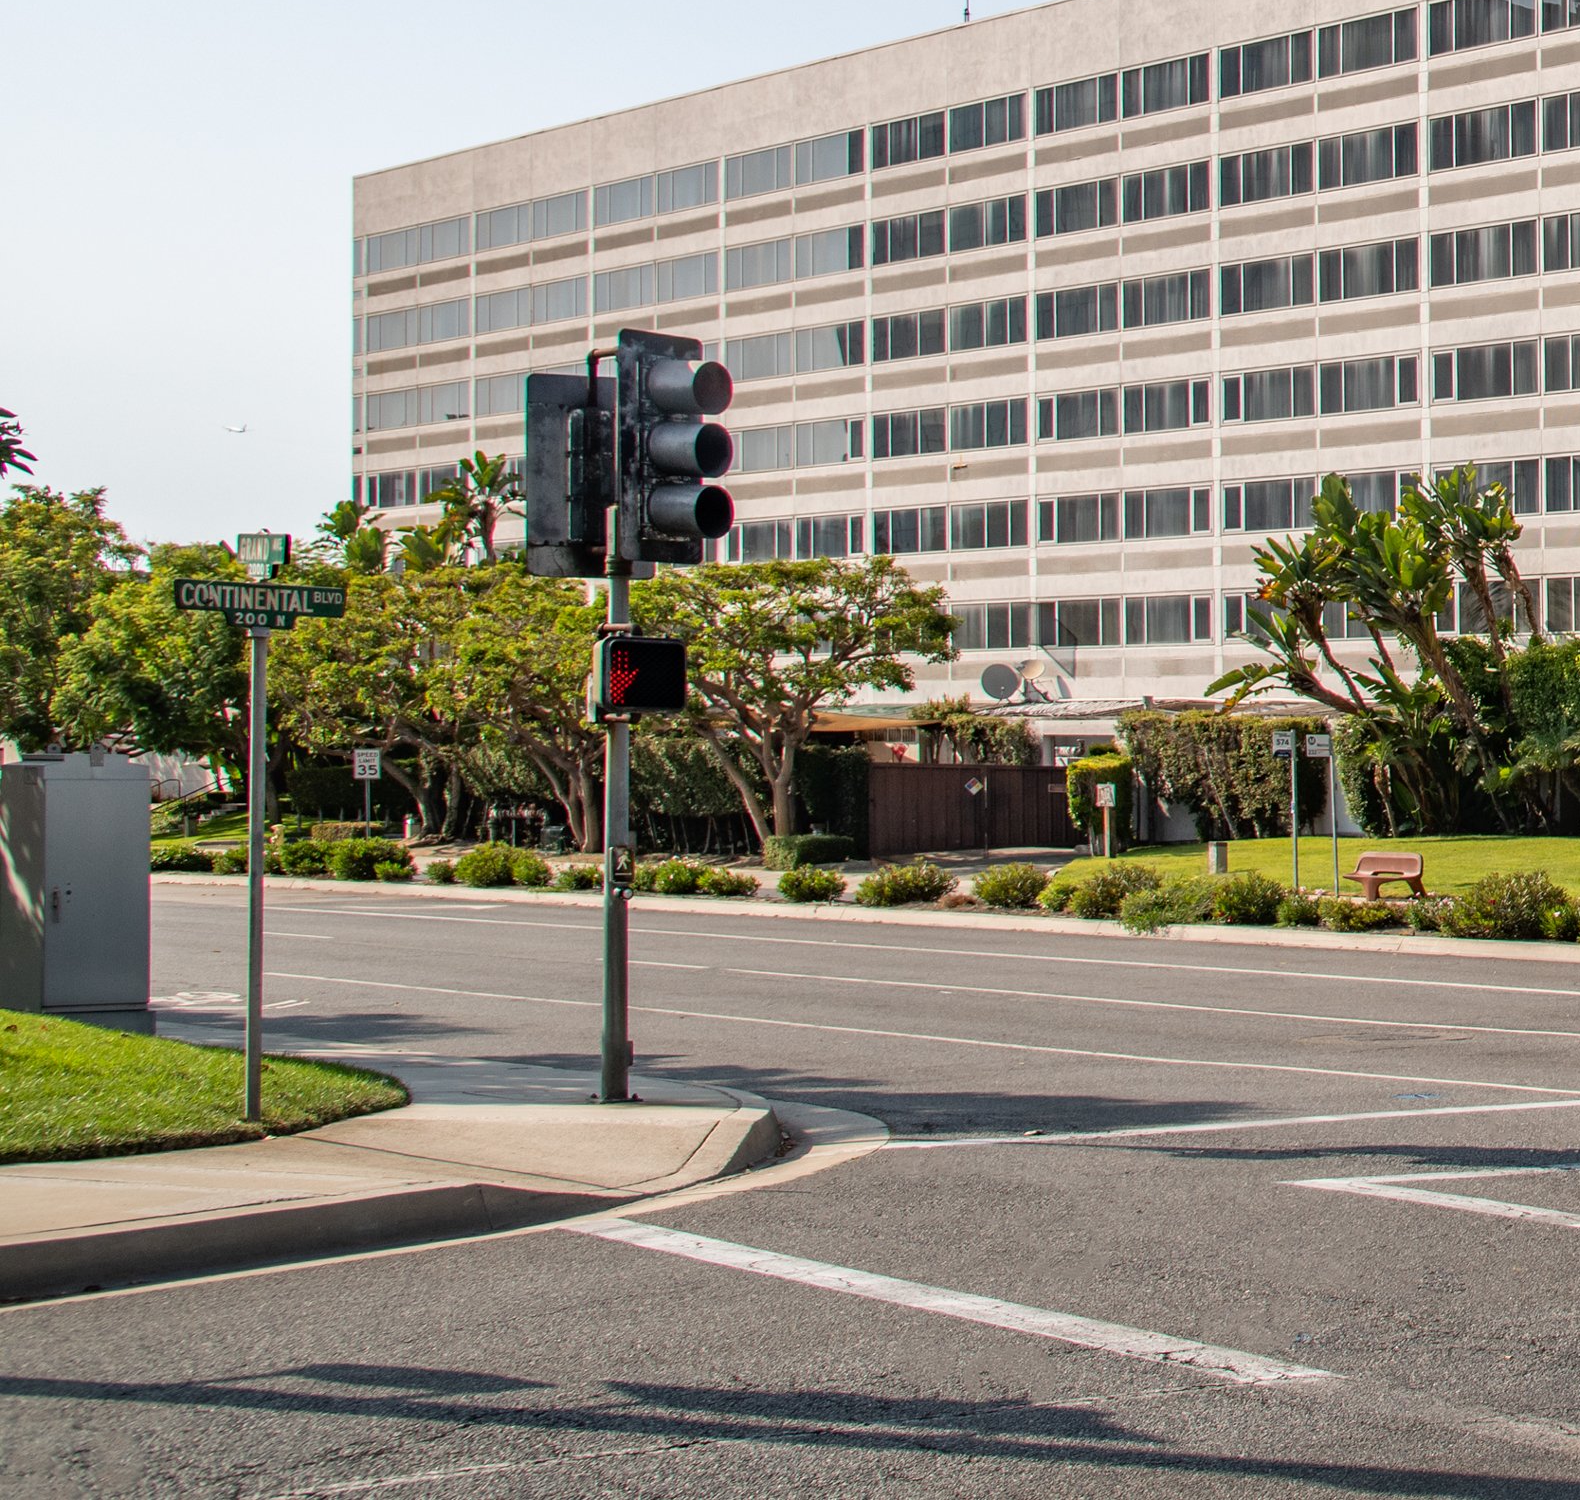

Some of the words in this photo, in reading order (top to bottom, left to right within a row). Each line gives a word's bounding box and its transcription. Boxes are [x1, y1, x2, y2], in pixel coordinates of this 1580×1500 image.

[239, 537, 269, 561] GRAND
[181, 583, 314, 613] CONTINENTAL
[313, 591, 343, 605] BLVD
[235, 612, 268, 626] 200
[276, 615, 286, 627] N
[1276, 738, 1290, 746] 574
[357, 764, 378, 776] 35
